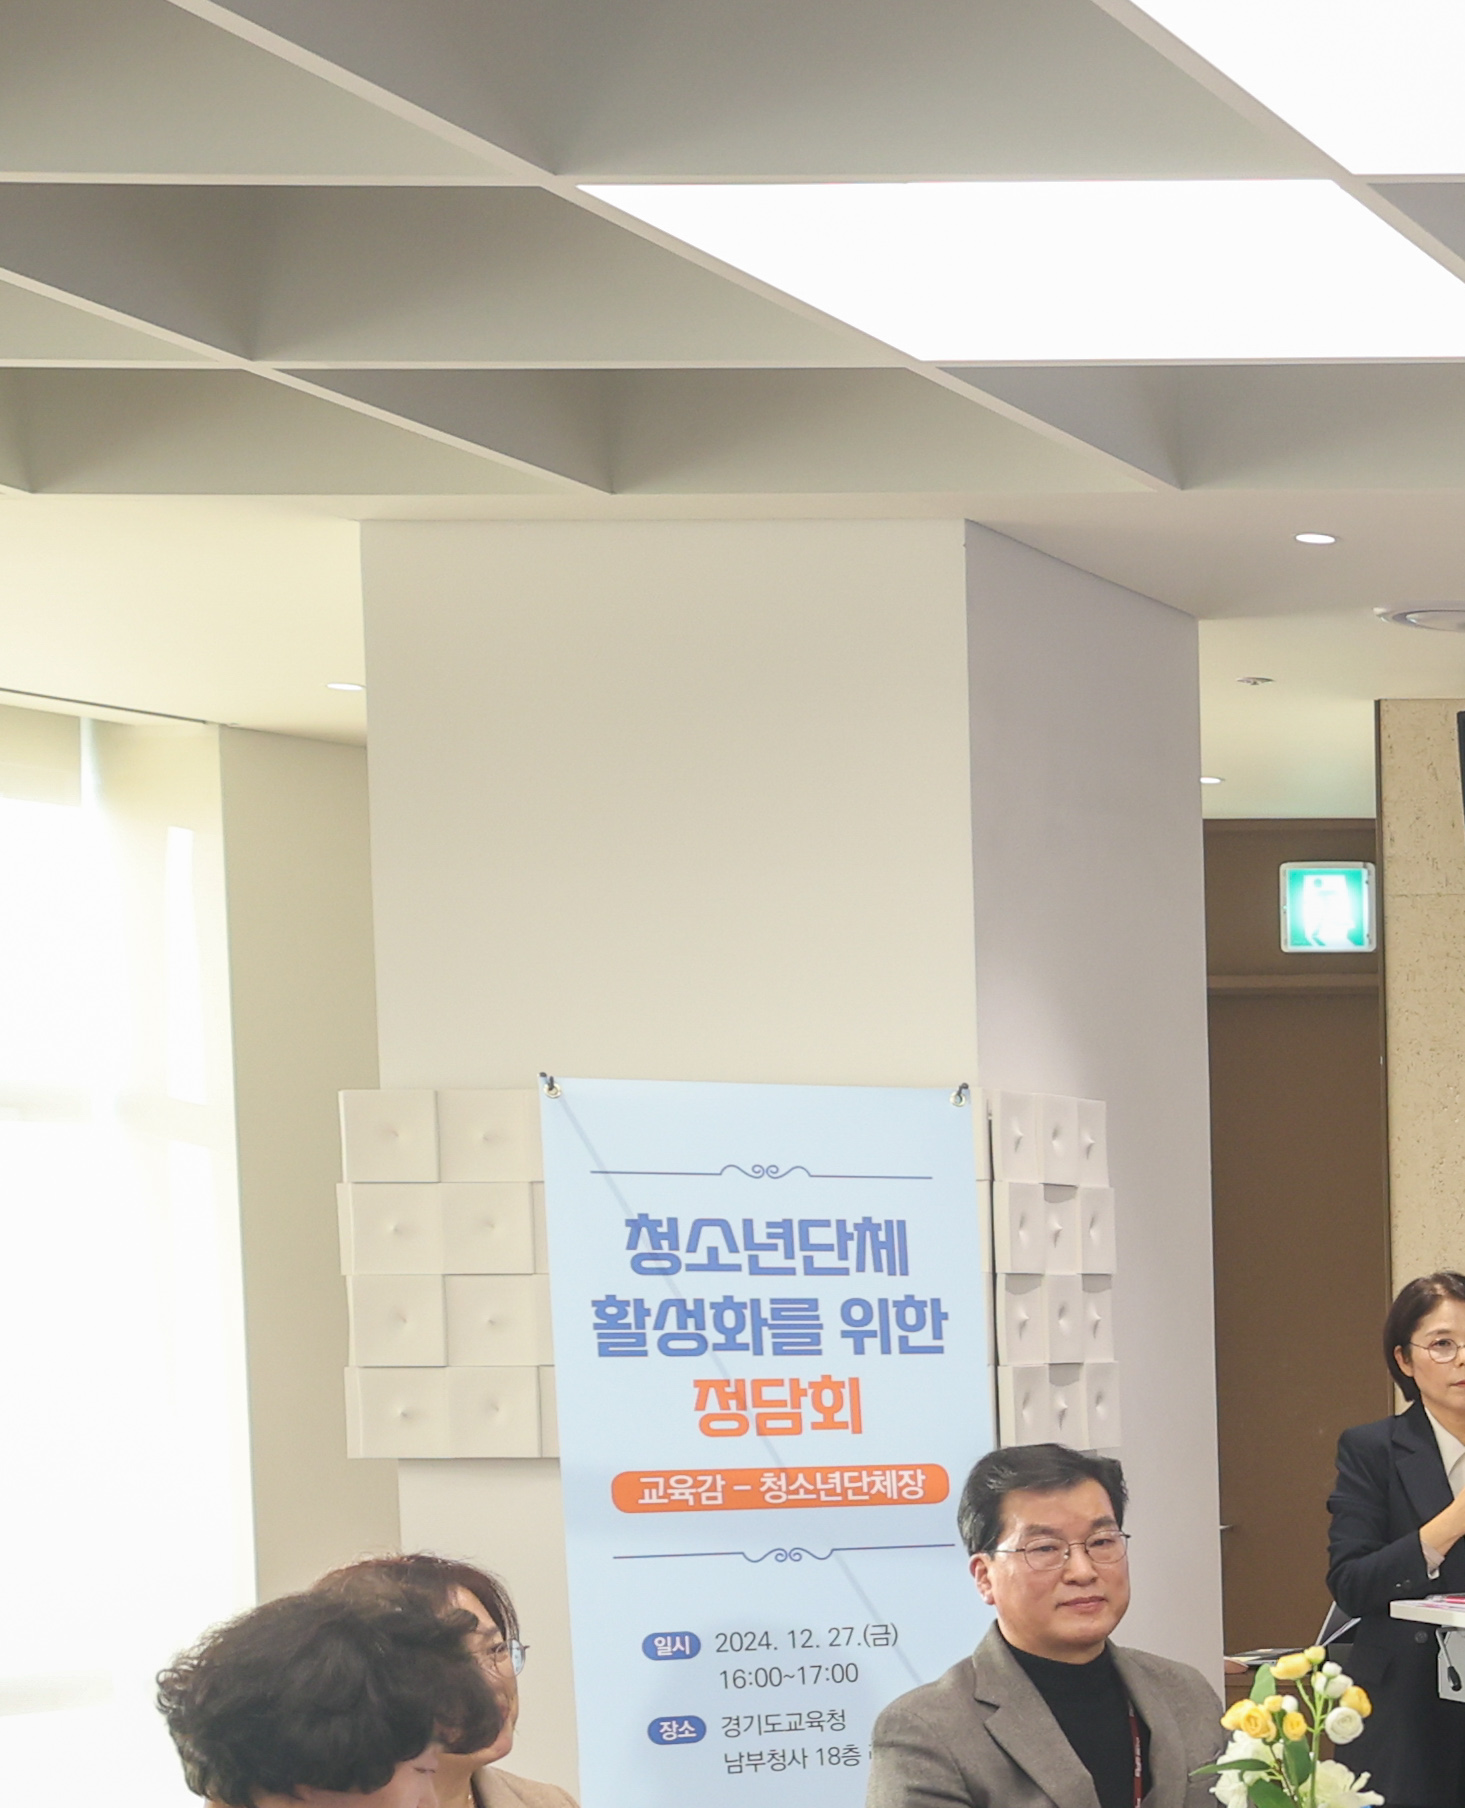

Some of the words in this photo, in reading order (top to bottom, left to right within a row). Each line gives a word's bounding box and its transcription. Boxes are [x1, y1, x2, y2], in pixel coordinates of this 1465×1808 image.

[625, 1213, 909, 1277] 청소년단체
[591, 1294, 823, 1357] 활성화를
[840, 1294, 948, 1356] 위한
[693, 1374, 862, 1437] 정담회
[638, 1474, 725, 1505] 교육감
[759, 1469, 926, 1504] 청소년단체장
[653, 1634, 691, 1656] 일시
[715, 1630, 779, 1654] 2024.
[787, 1628, 820, 1651] 12.
[827, 1622, 898, 1648] 27.(금)
[719, 1662, 859, 1690] 16:00~17:00
[659, 1719, 697, 1741] 장소
[721, 1708, 846, 1739] 경기도교육청
[723, 1748, 808, 1775] 남부청사
[815, 1744, 862, 1769] 18층
